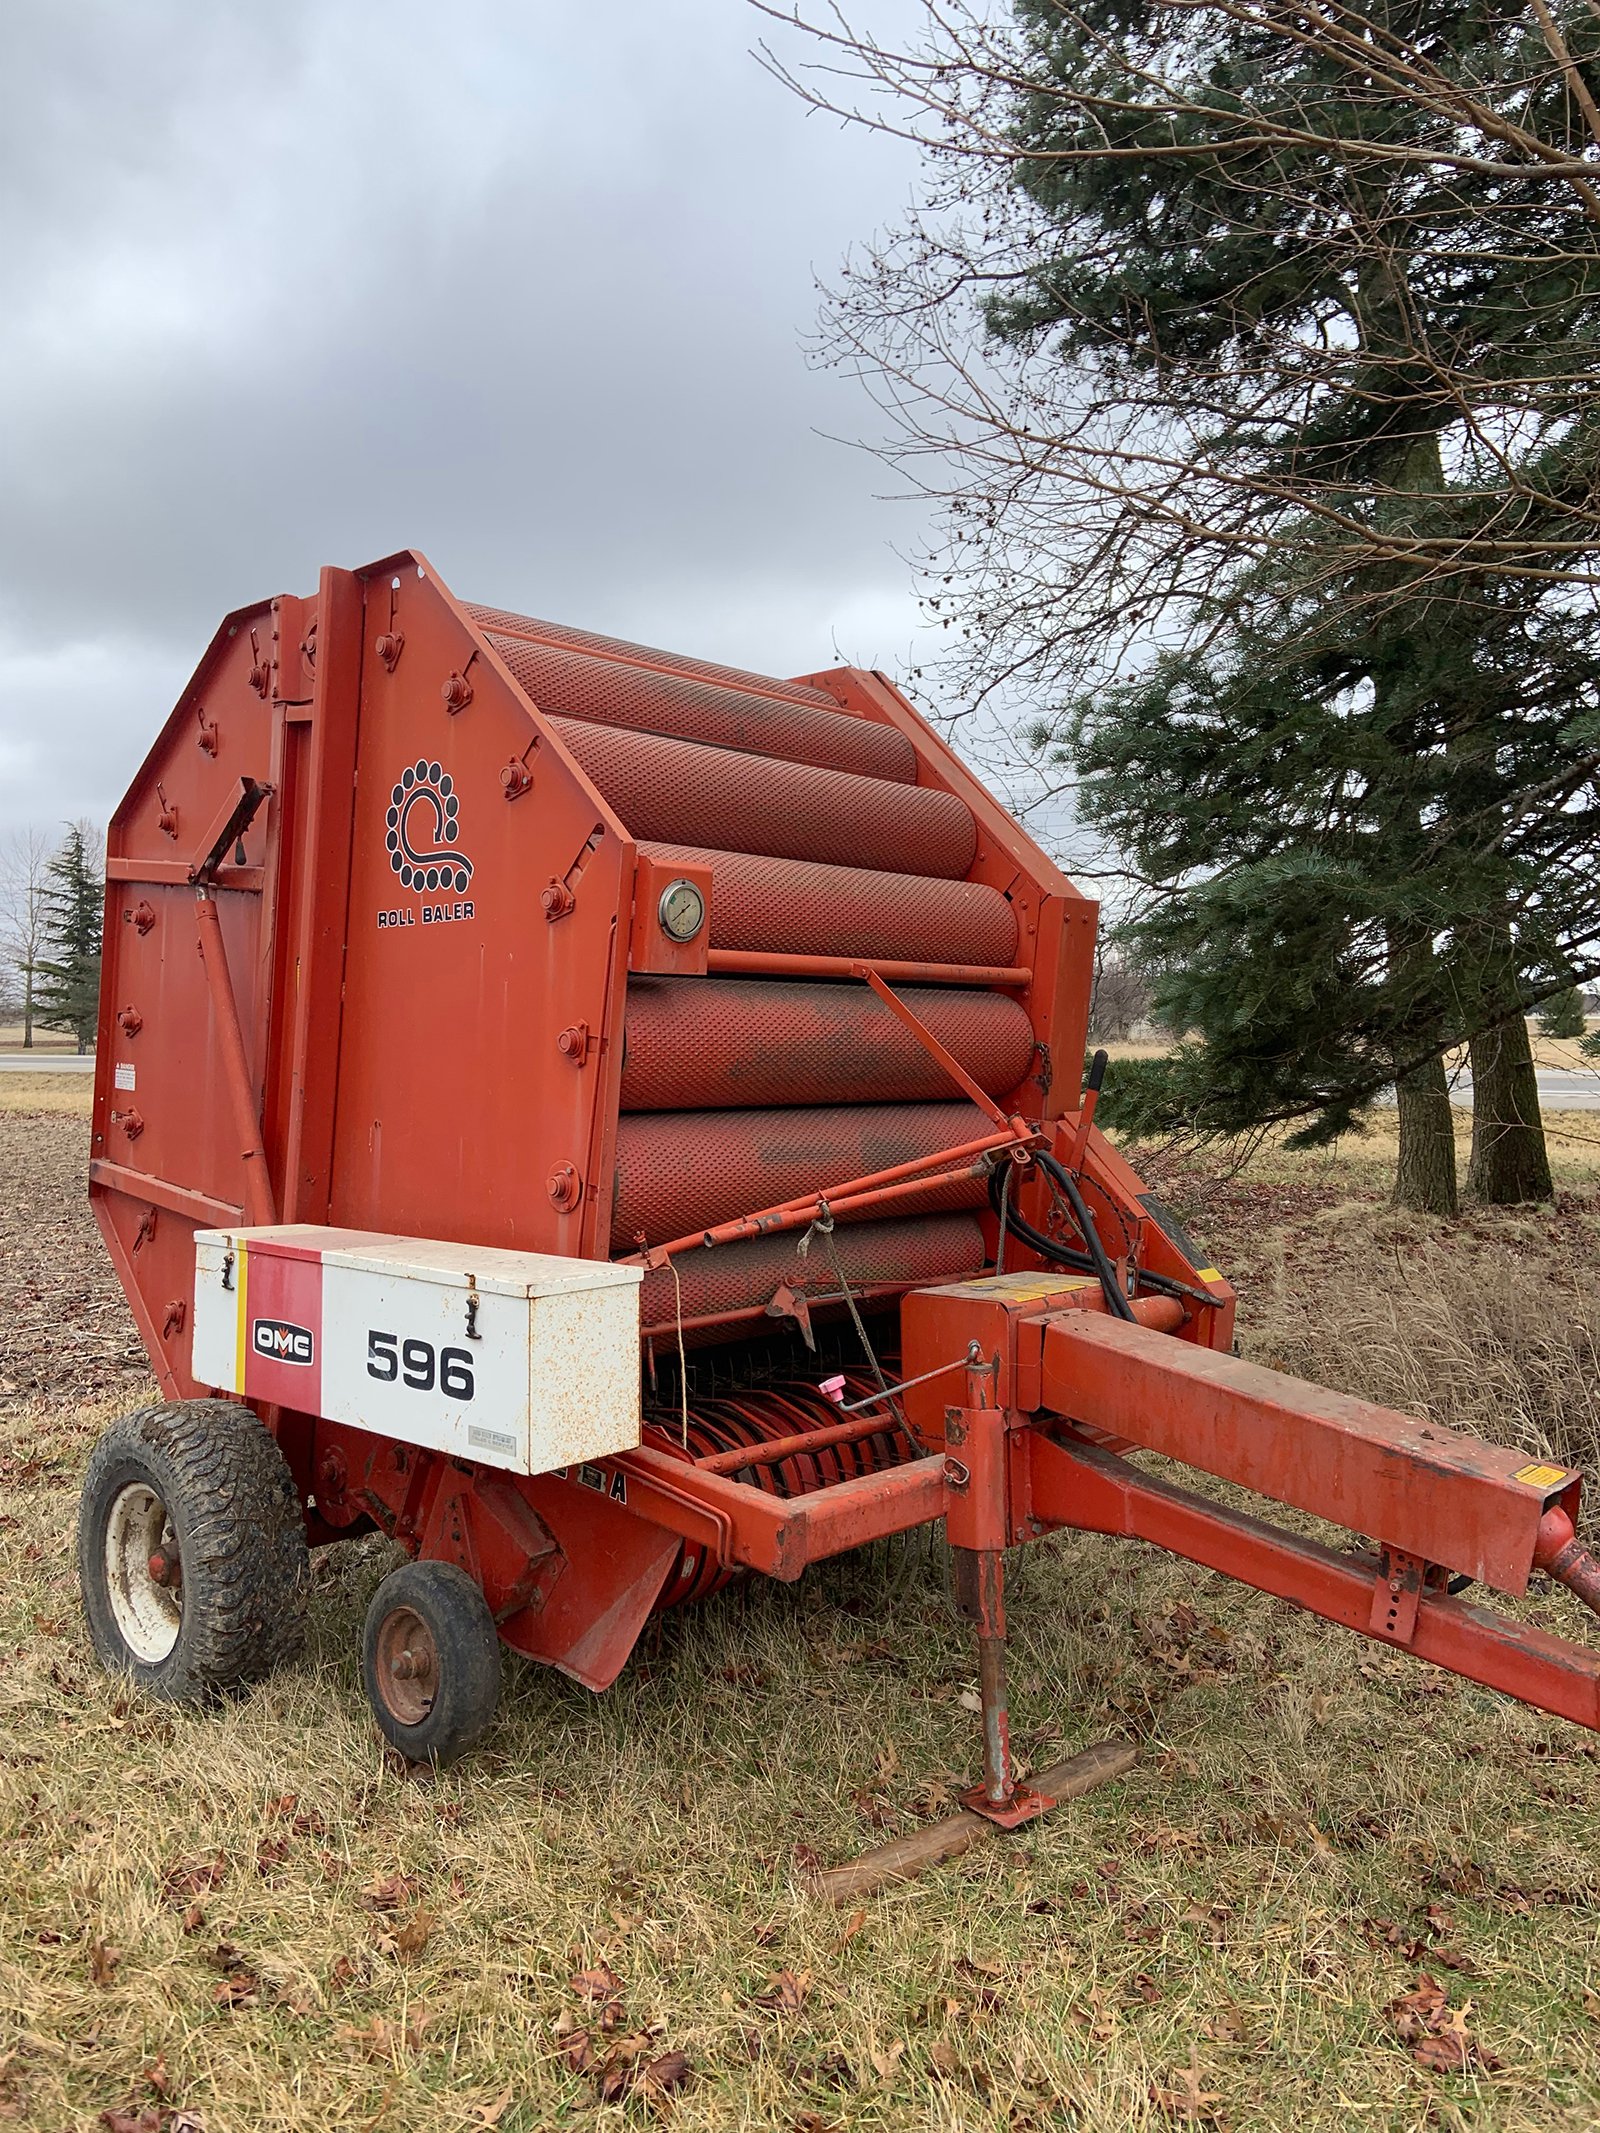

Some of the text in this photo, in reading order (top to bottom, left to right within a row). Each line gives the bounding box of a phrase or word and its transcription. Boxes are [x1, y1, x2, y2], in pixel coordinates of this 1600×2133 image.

[378, 901, 475, 928] ROLL BALER
[257, 1326, 310, 1357] OMC
[367, 1329, 475, 1402] 596
